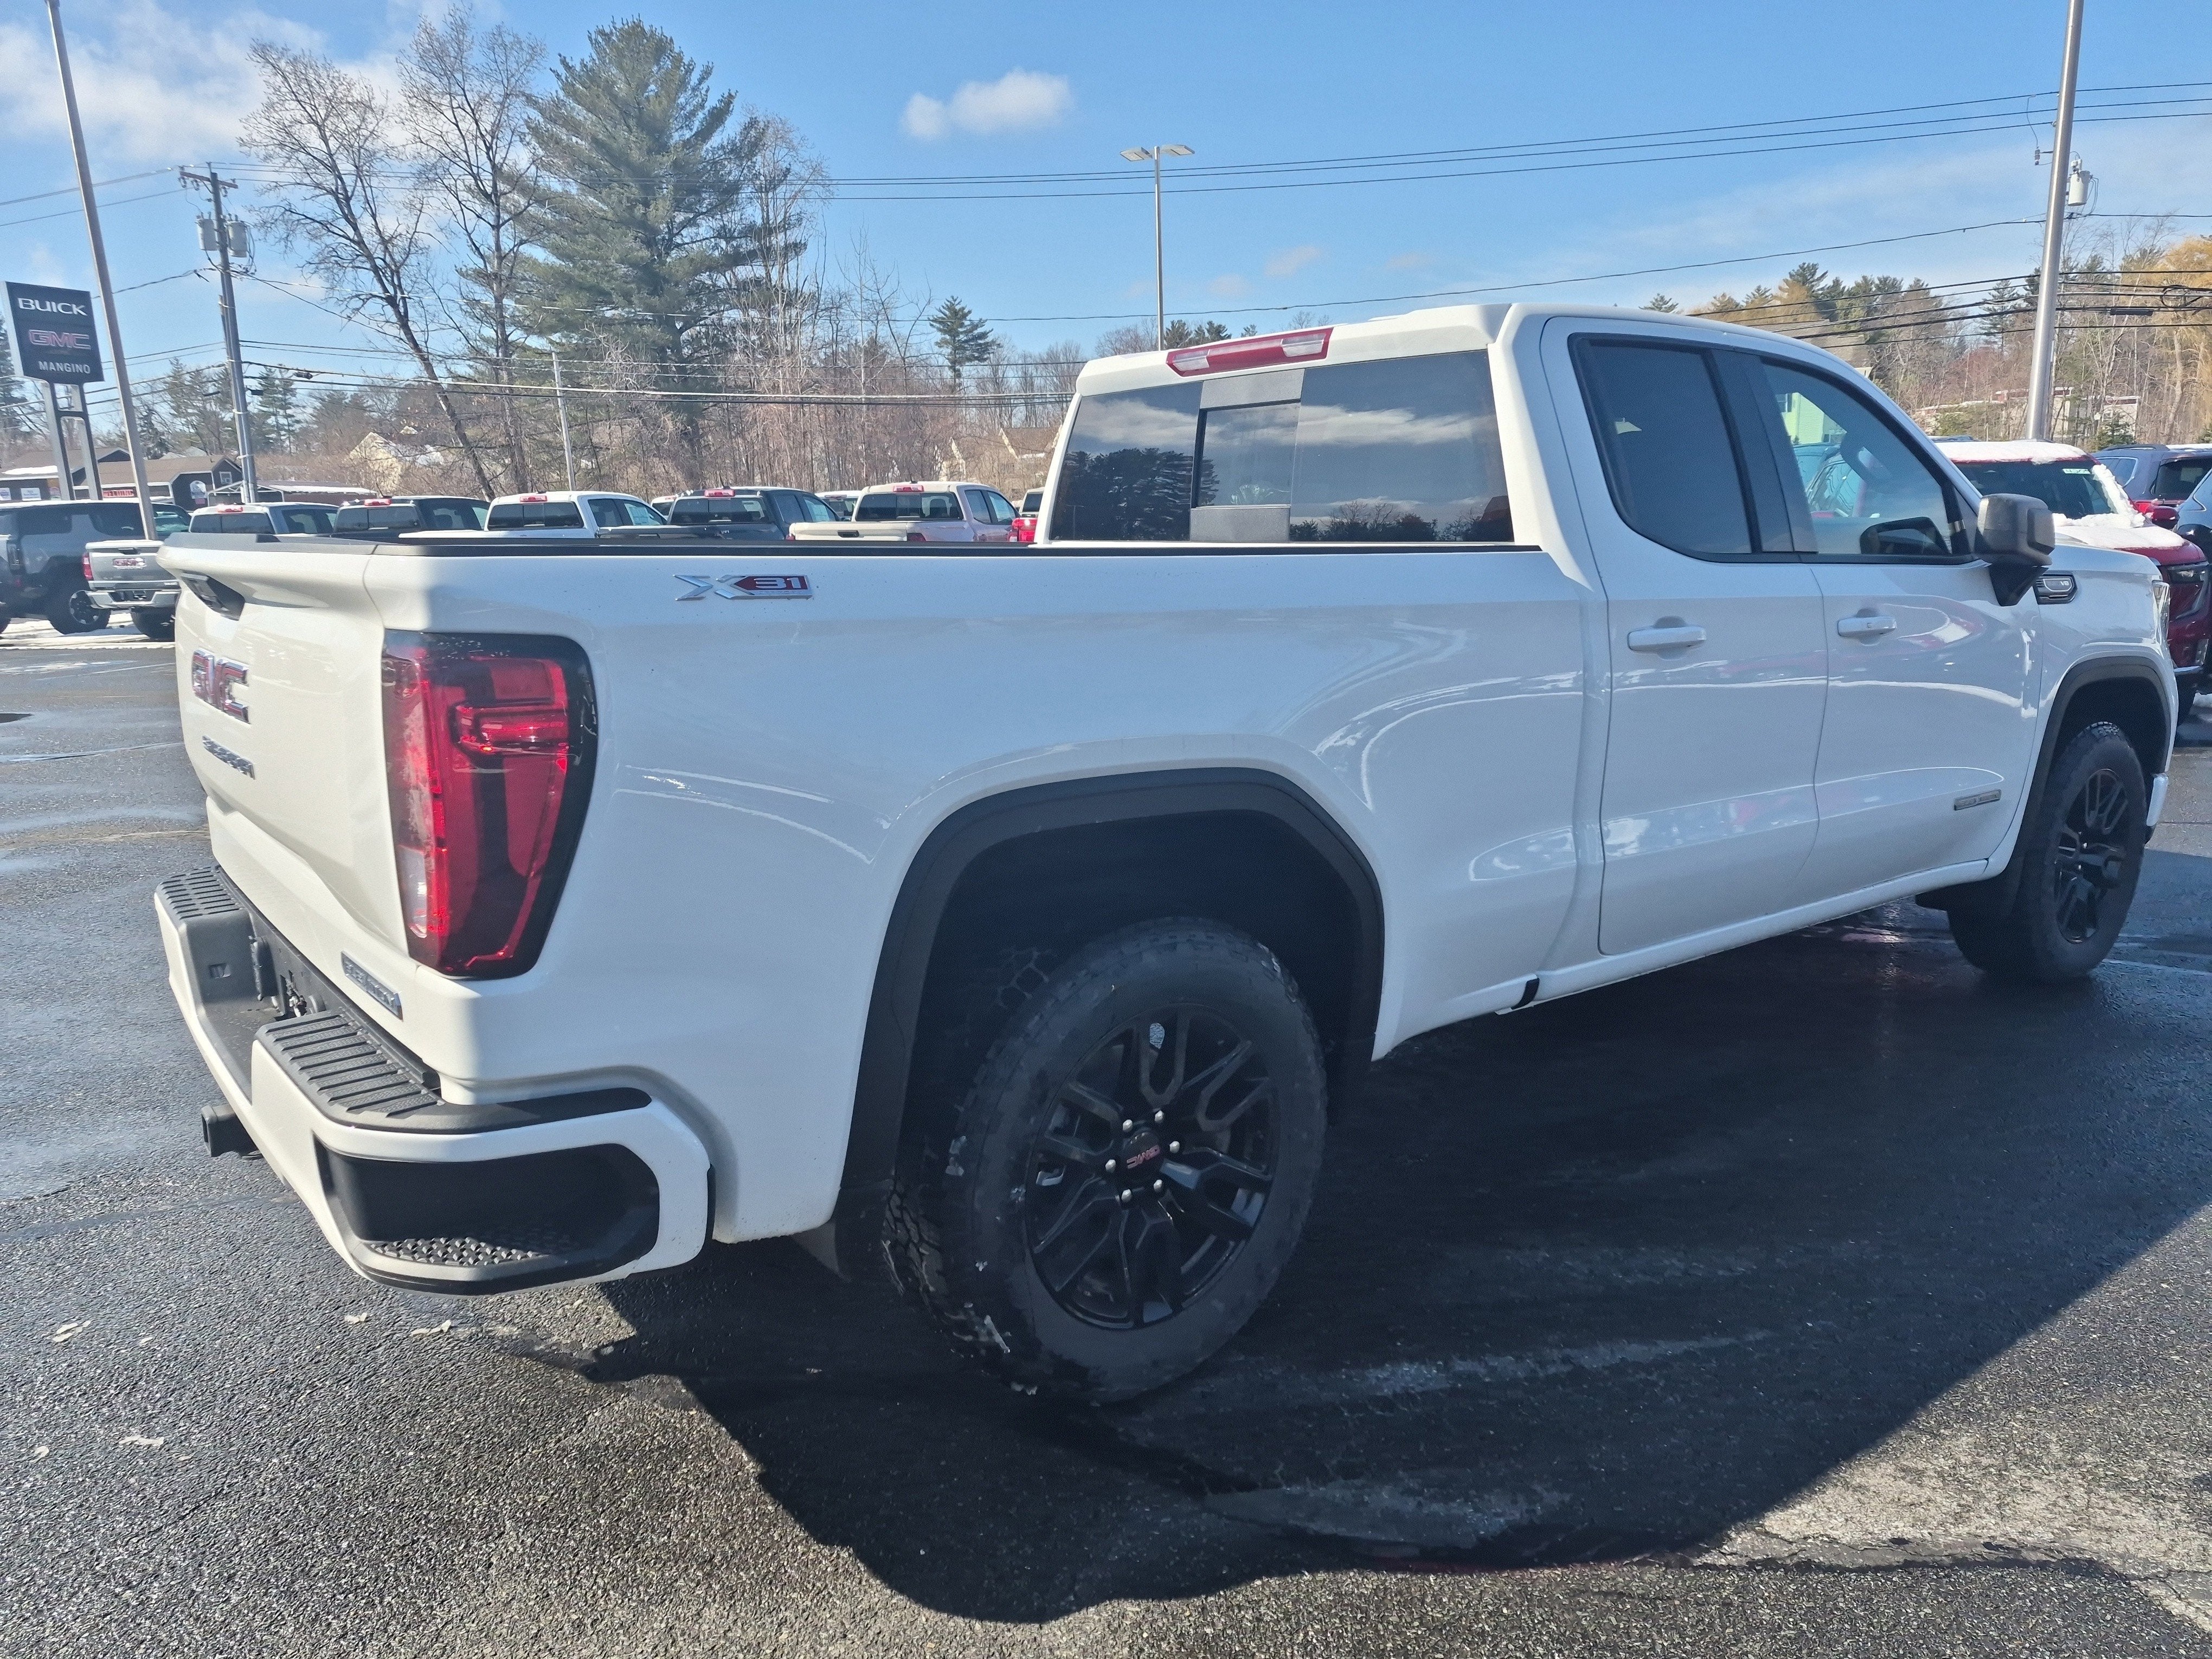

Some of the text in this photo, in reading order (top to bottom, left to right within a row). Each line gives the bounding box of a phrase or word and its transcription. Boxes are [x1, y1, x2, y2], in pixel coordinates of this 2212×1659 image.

[17, 297, 88, 316] BUICK
[28, 329, 91, 350] GMC
[37, 360, 91, 374] MANGINO
[1126, 1144, 1160, 1169] GMC
